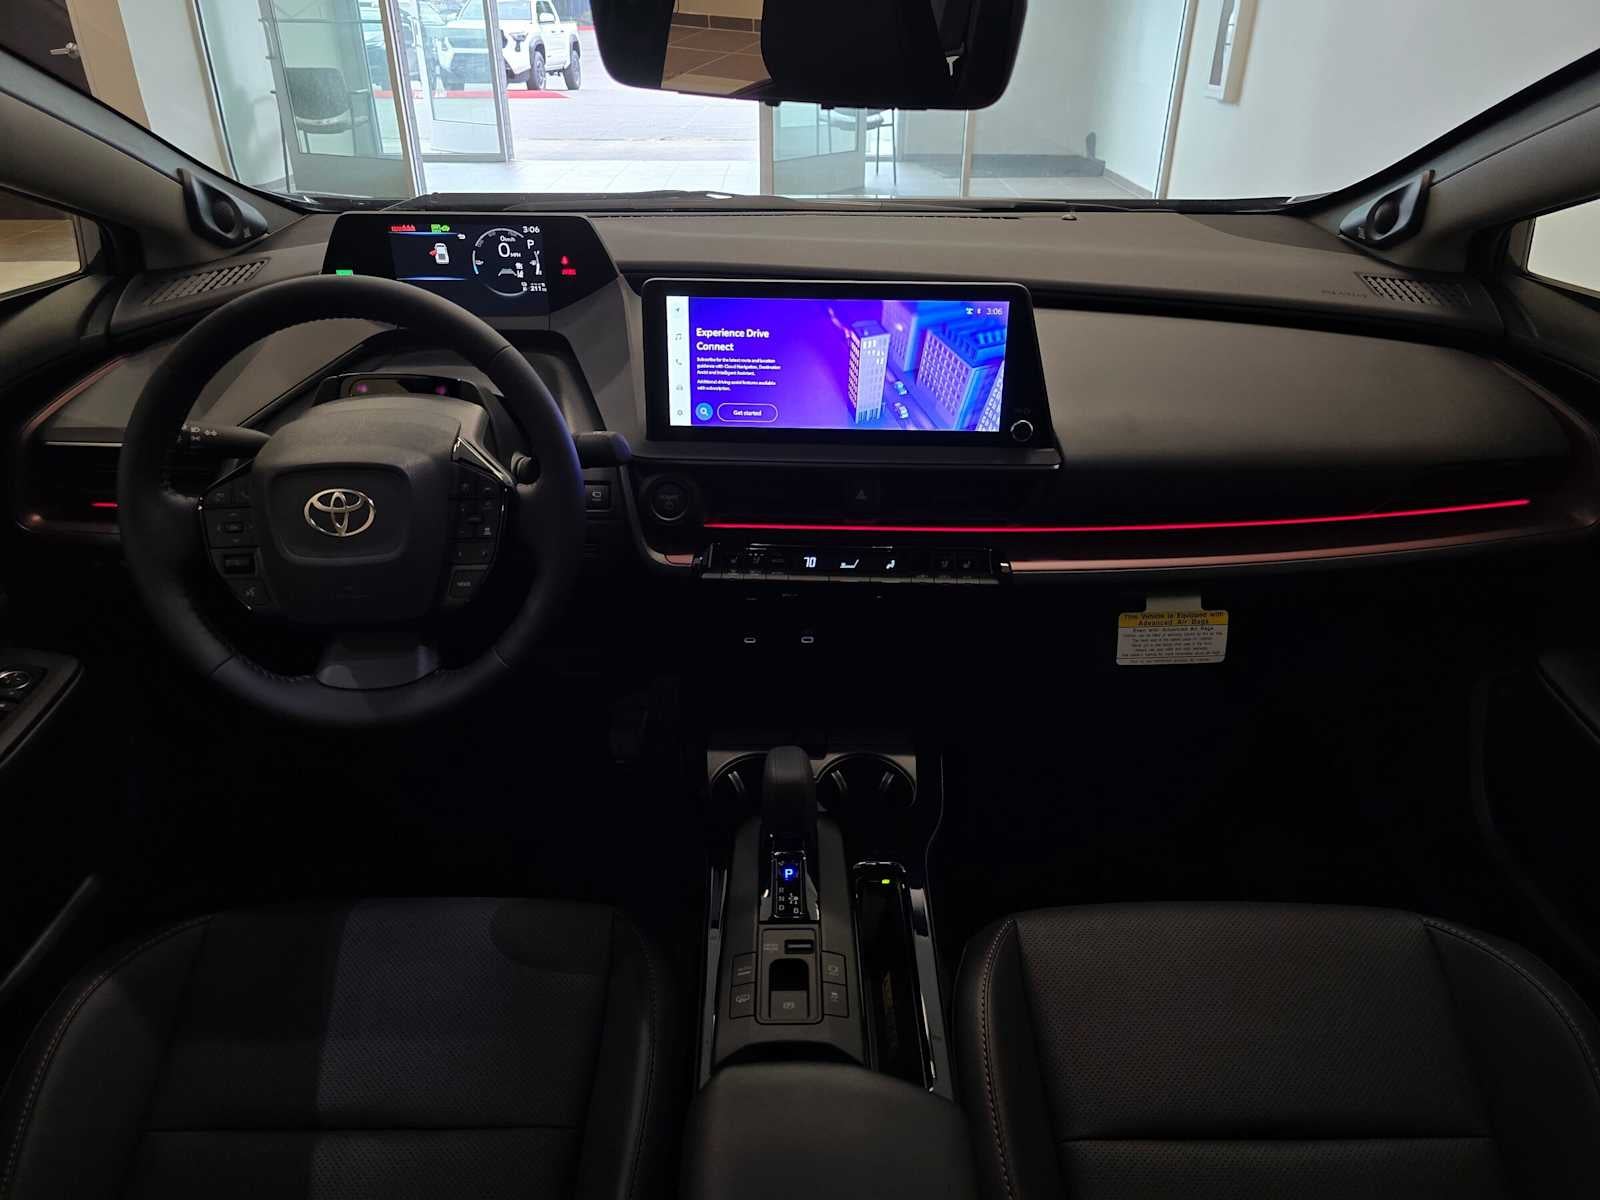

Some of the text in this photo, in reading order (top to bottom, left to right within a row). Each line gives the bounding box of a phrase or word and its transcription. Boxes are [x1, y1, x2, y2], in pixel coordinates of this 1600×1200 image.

[523, 226, 540, 234] 3:06
[527, 240, 534, 250] P
[498, 243, 510, 258] 0
[985, 307, 1003, 316] 3:06
[696, 328, 770, 339] Experience Drive
[696, 342, 734, 352] Connect
[803, 556, 816, 568] 70
[784, 868, 793, 880] P
